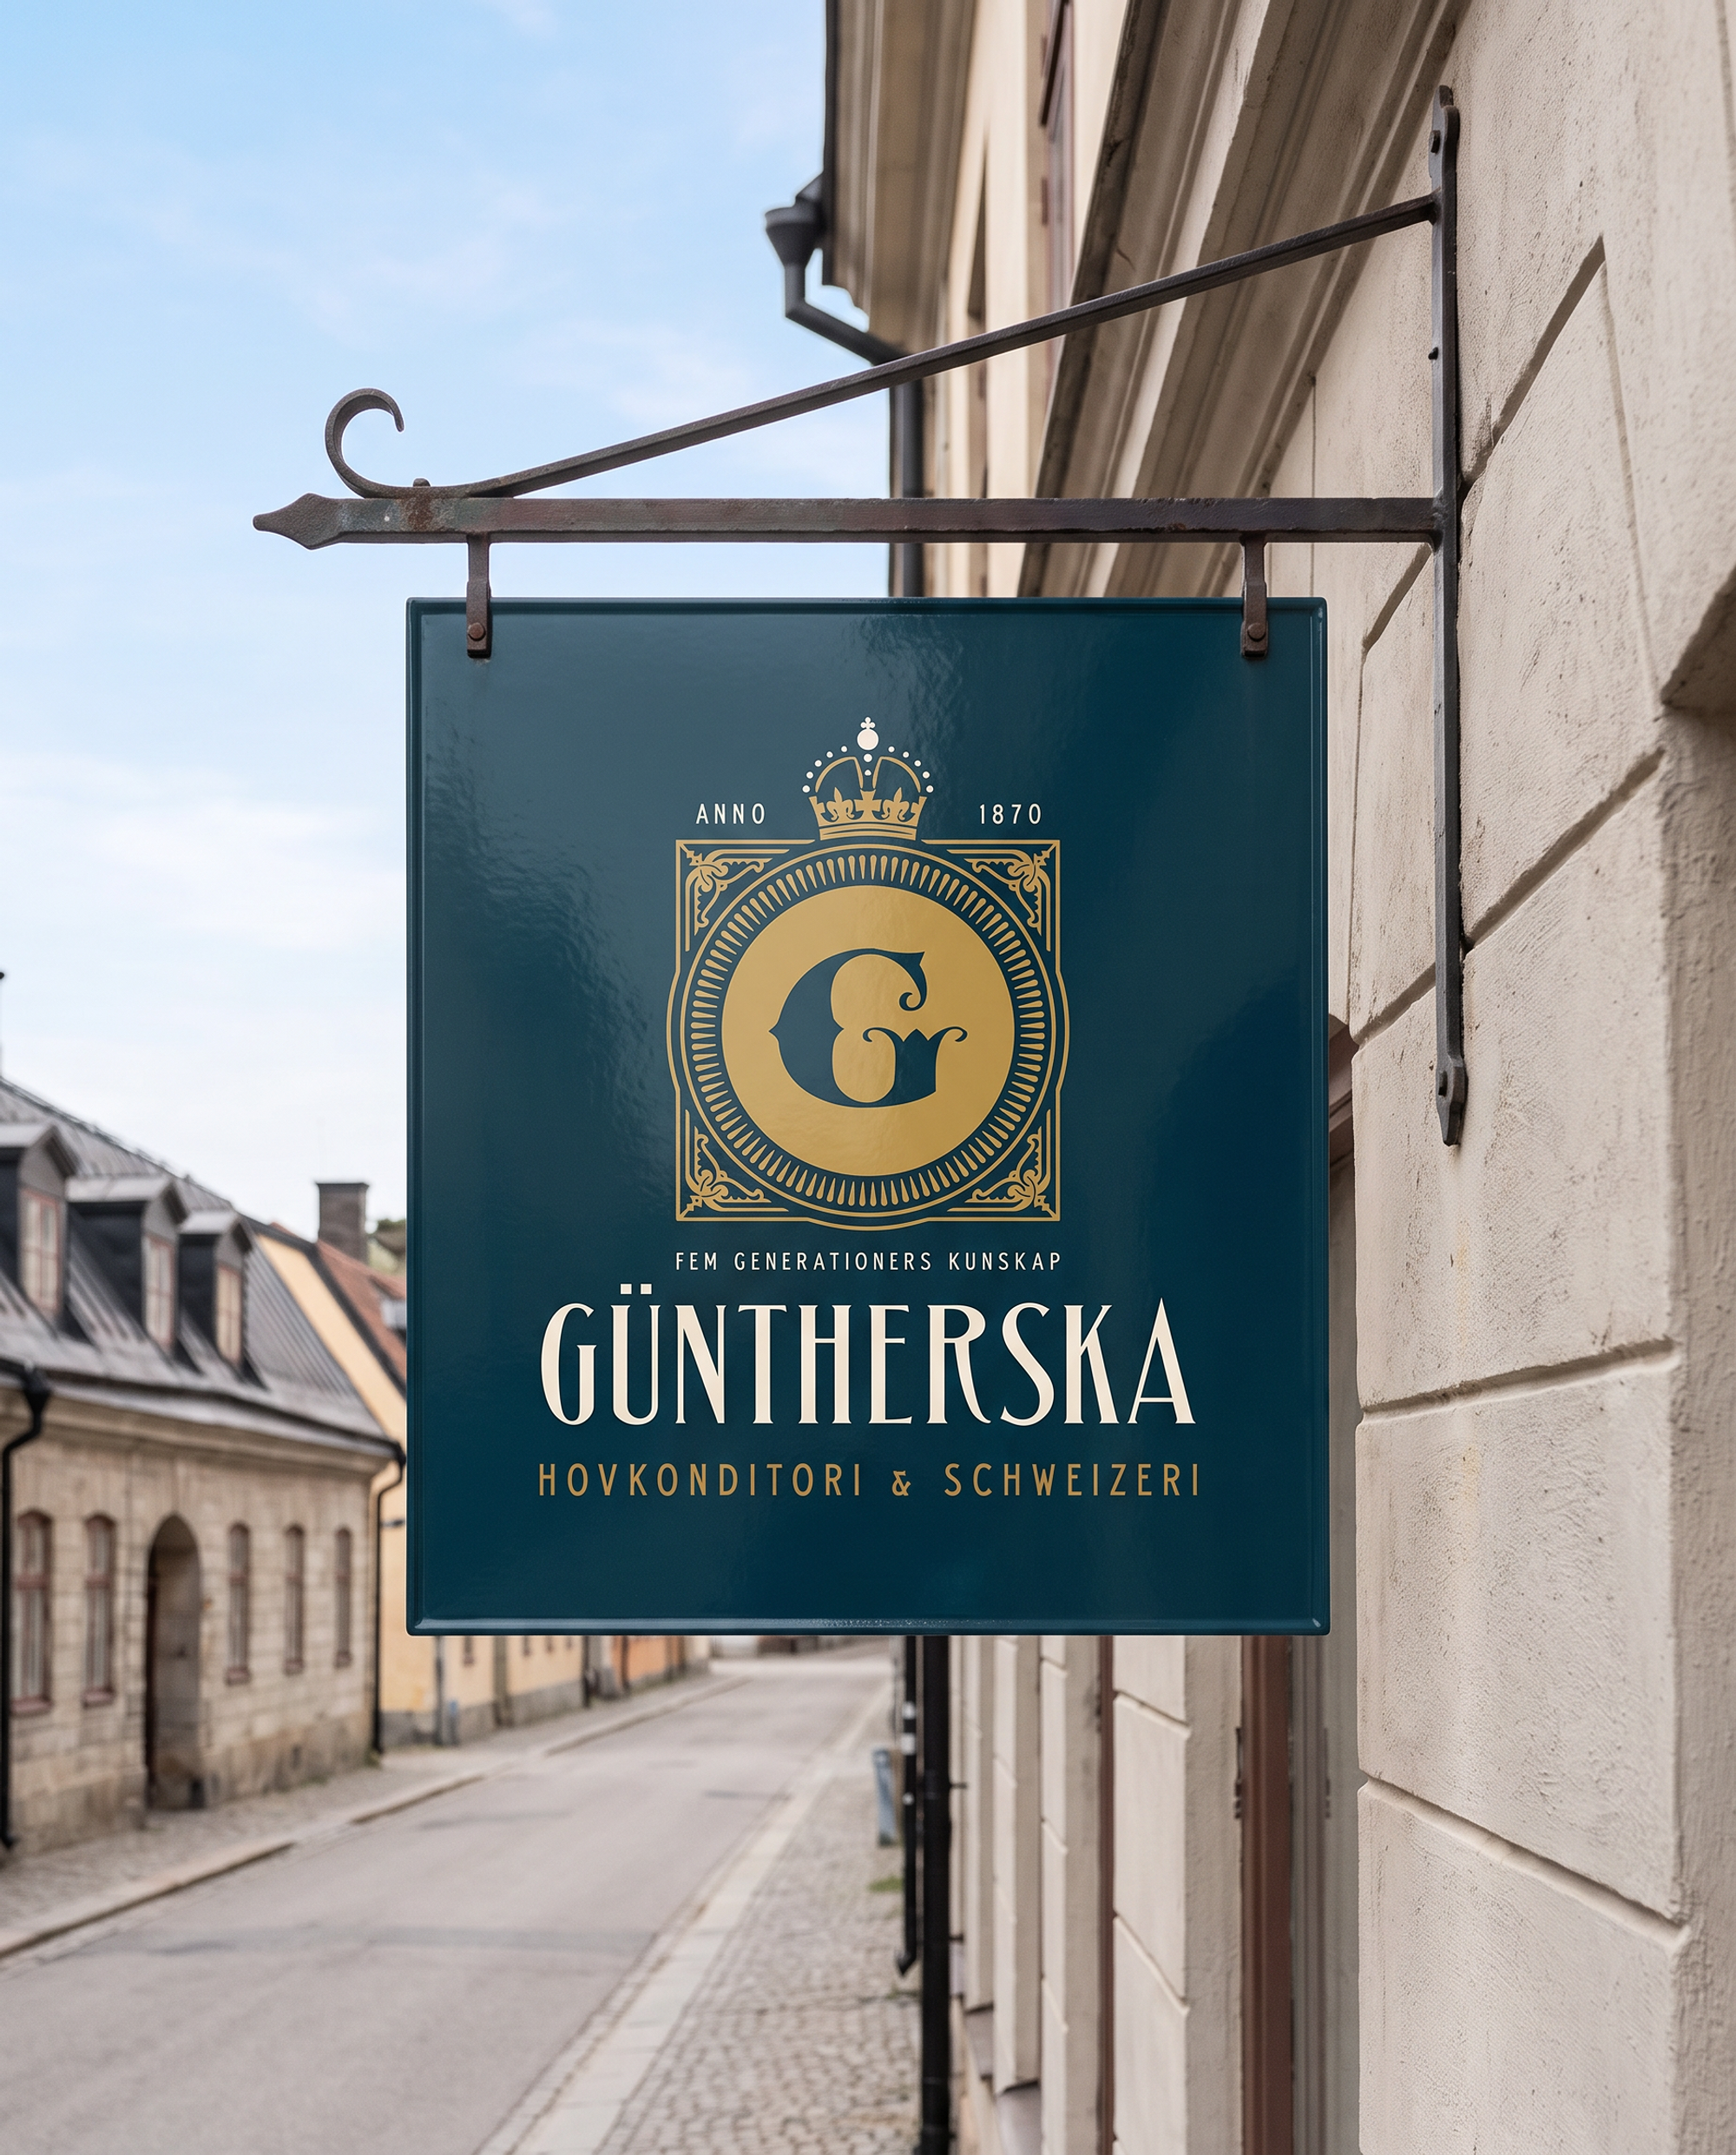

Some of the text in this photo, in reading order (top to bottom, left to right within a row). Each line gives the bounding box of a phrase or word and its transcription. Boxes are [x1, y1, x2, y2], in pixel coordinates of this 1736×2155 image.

[695, 803, 1042, 825] ANNO 1870
[768, 948, 968, 1108] G
[675, 1252, 1062, 1271] FEM GENERATIONERS KUNSKAP
[541, 1284, 1196, 1427] GÜNTHERSKA
[538, 1462, 1200, 1497] HOVKONDITORI & SCHWEIZERI
